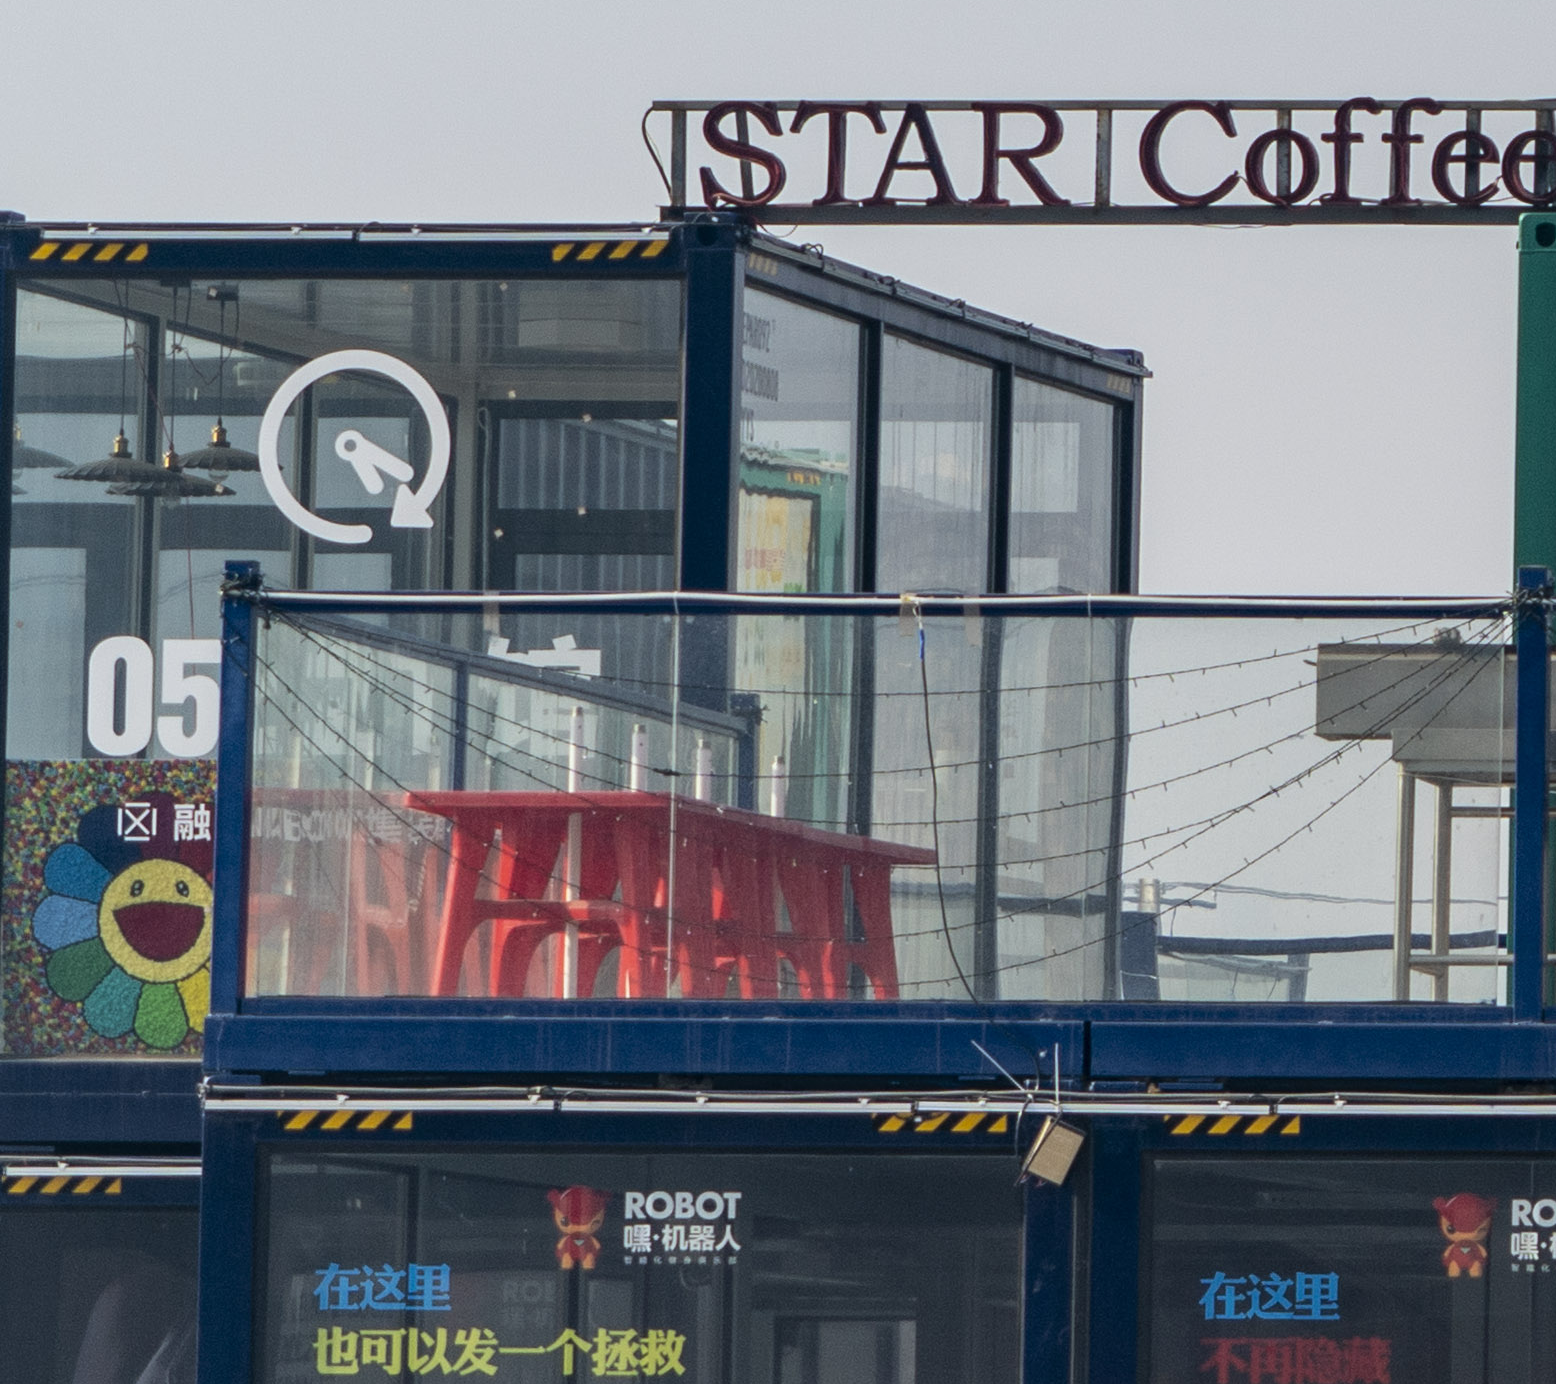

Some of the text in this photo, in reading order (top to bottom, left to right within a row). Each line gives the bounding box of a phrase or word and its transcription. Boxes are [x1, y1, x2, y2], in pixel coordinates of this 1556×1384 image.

[700, 99, 1069, 207] STAR
[87, 635, 222, 758] 05
[625, 1192, 741, 1219] ROBOT
[313, 1263, 452, 1312] 在这里
[1199, 1272, 1340, 1321] 在这里
[312, 1327, 686, 1376] 也可以发一个拯救
